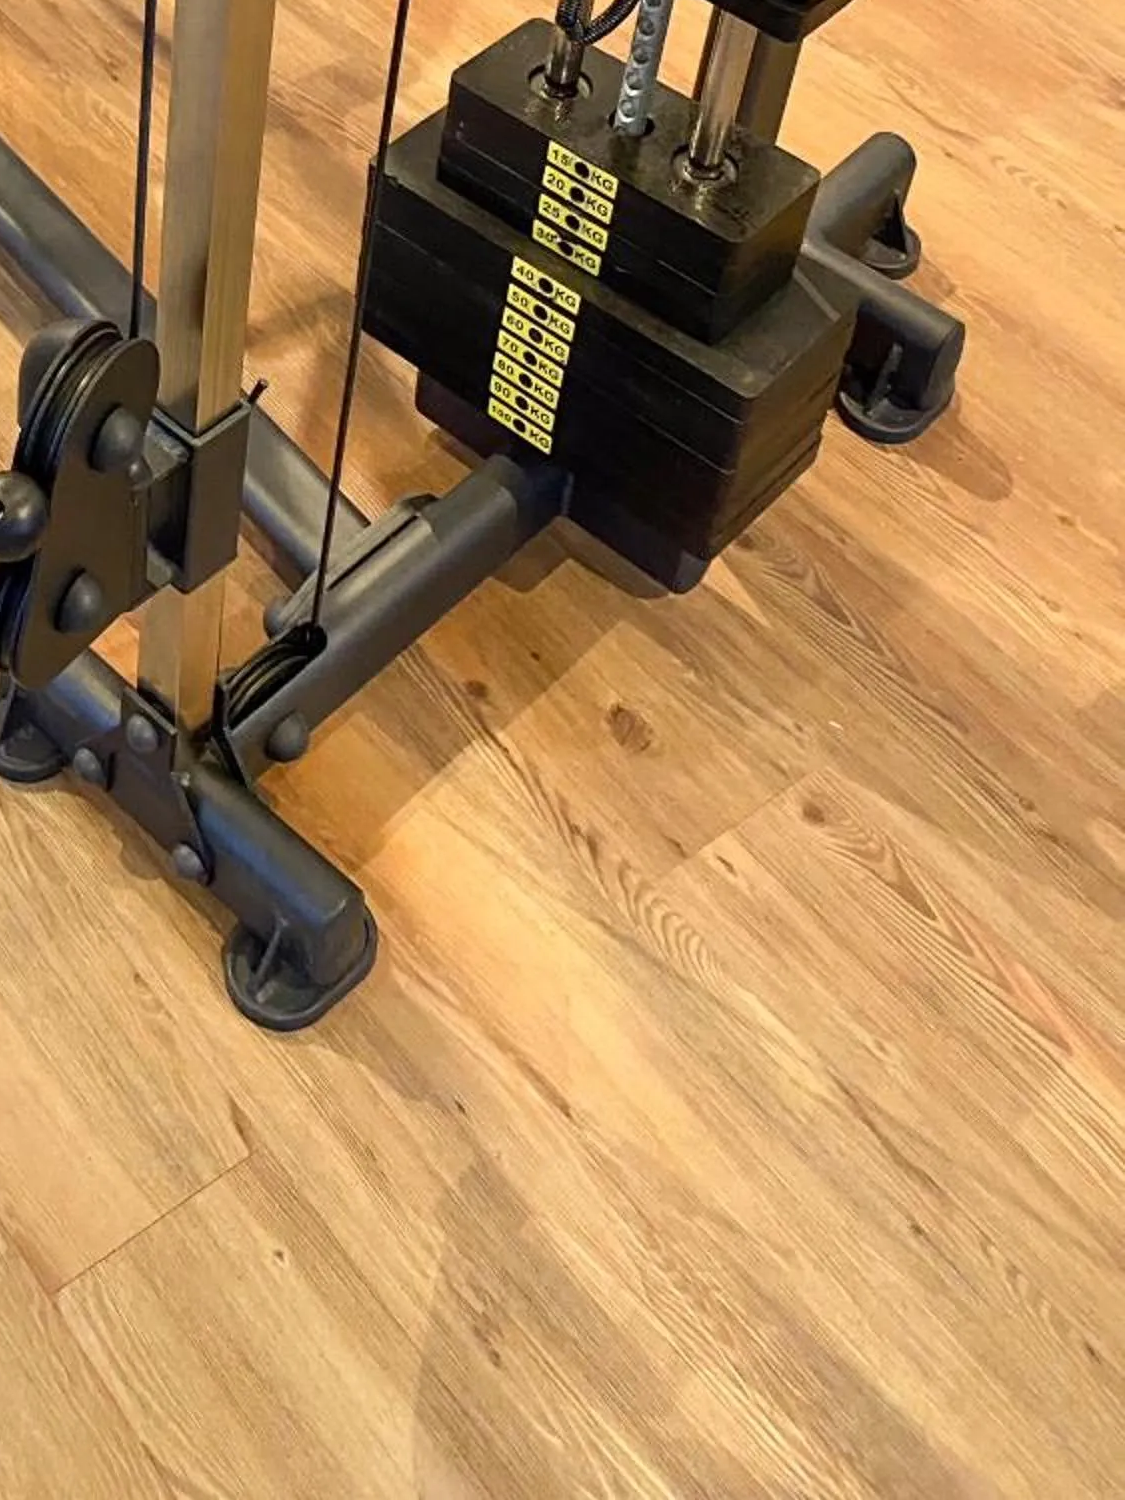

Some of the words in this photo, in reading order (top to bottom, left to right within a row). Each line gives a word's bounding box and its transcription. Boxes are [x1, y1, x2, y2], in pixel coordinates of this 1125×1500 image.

[551, 149, 572, 164] 15
[590, 171, 614, 192] KG
[546, 173, 565, 191] 20
[586, 196, 609, 217] KG
[542, 201, 561, 219] 25
[581, 223, 604, 244] KG
[574, 248, 597, 269] KG
[515, 266, 535, 281] 40
[555, 288, 577, 308] KG
[511, 291, 529, 308] 50
[549, 313, 571, 335] KG
[506, 314, 525, 331] 60
[544, 336, 566, 358] KG
[497, 359, 515, 376] 80
[534, 383, 555, 403] KG
[502, 336, 520, 353] 70
[538, 360, 560, 382] KG
[494, 381, 511, 399] 90
[529, 405, 551, 425] KG
[491, 405, 513, 423] 100
[529, 429, 551, 449] KG
